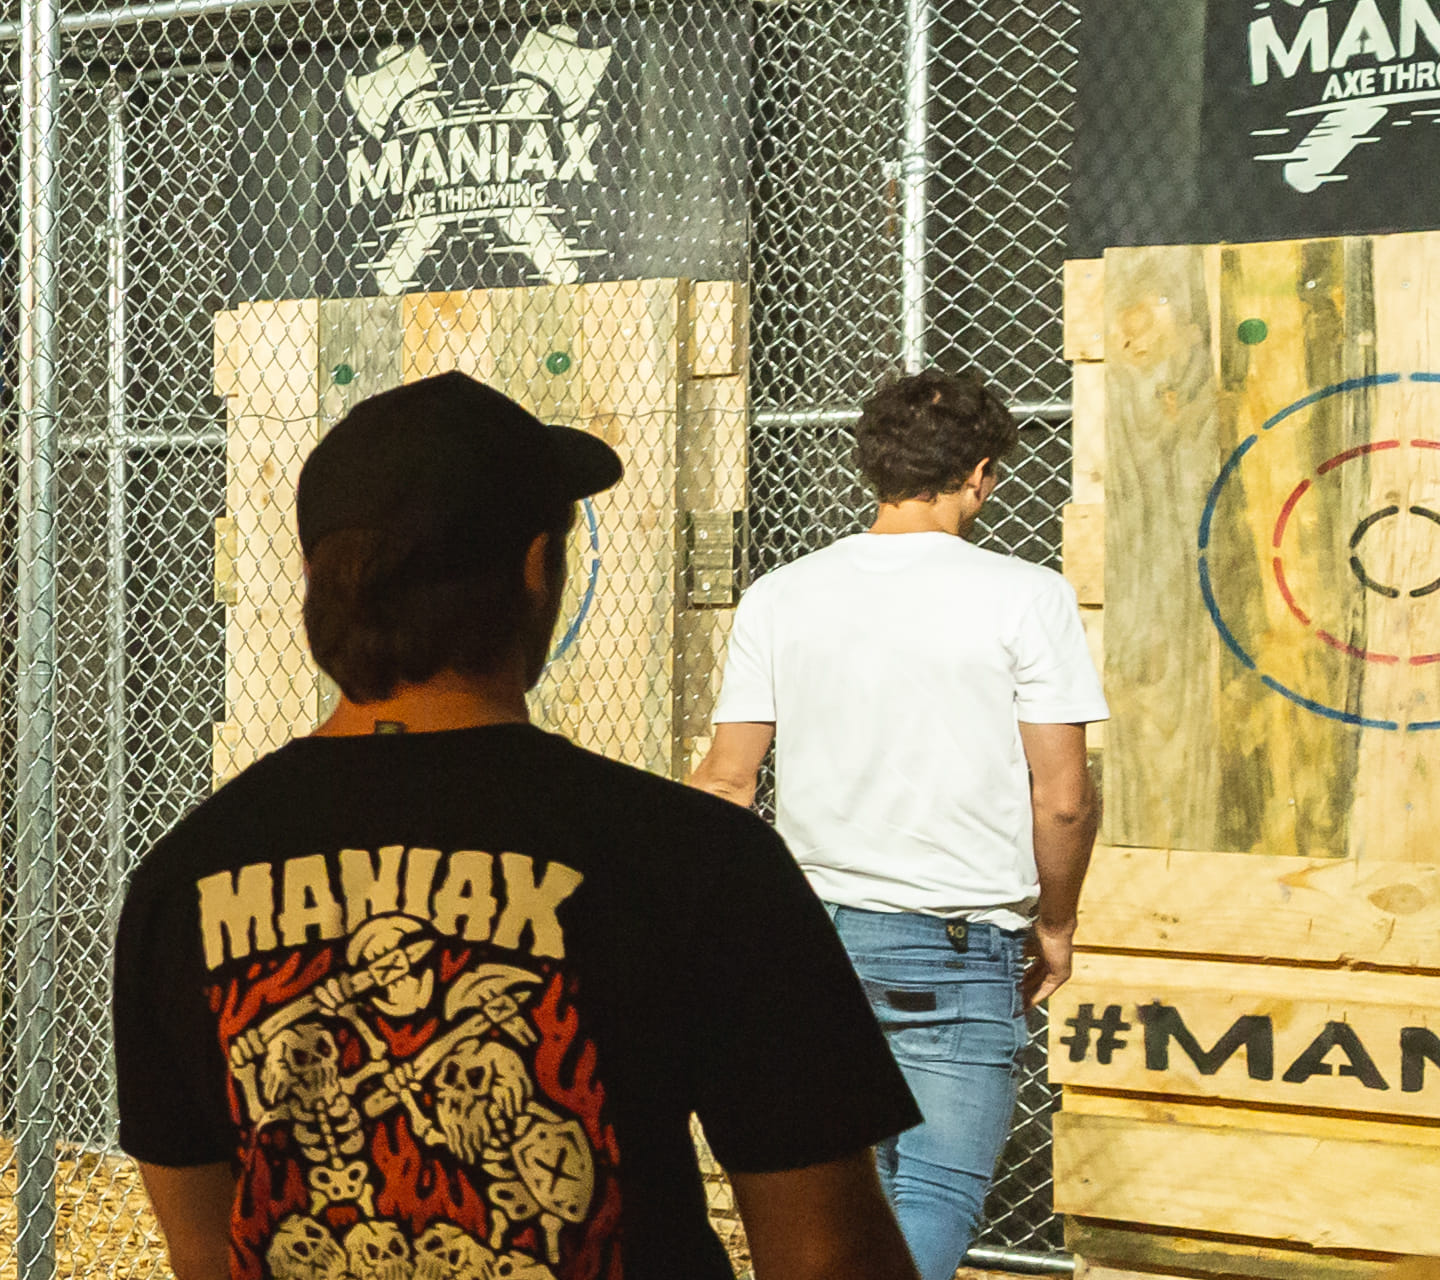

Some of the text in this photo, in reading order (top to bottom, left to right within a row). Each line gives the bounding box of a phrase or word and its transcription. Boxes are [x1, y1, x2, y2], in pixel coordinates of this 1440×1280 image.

[1321, 61, 1440, 101] AXE THR
[347, 122, 601, 205] MANIAX
[399, 182, 548, 220] AXE THROWING
[197, 845, 584, 971] MANIAX
